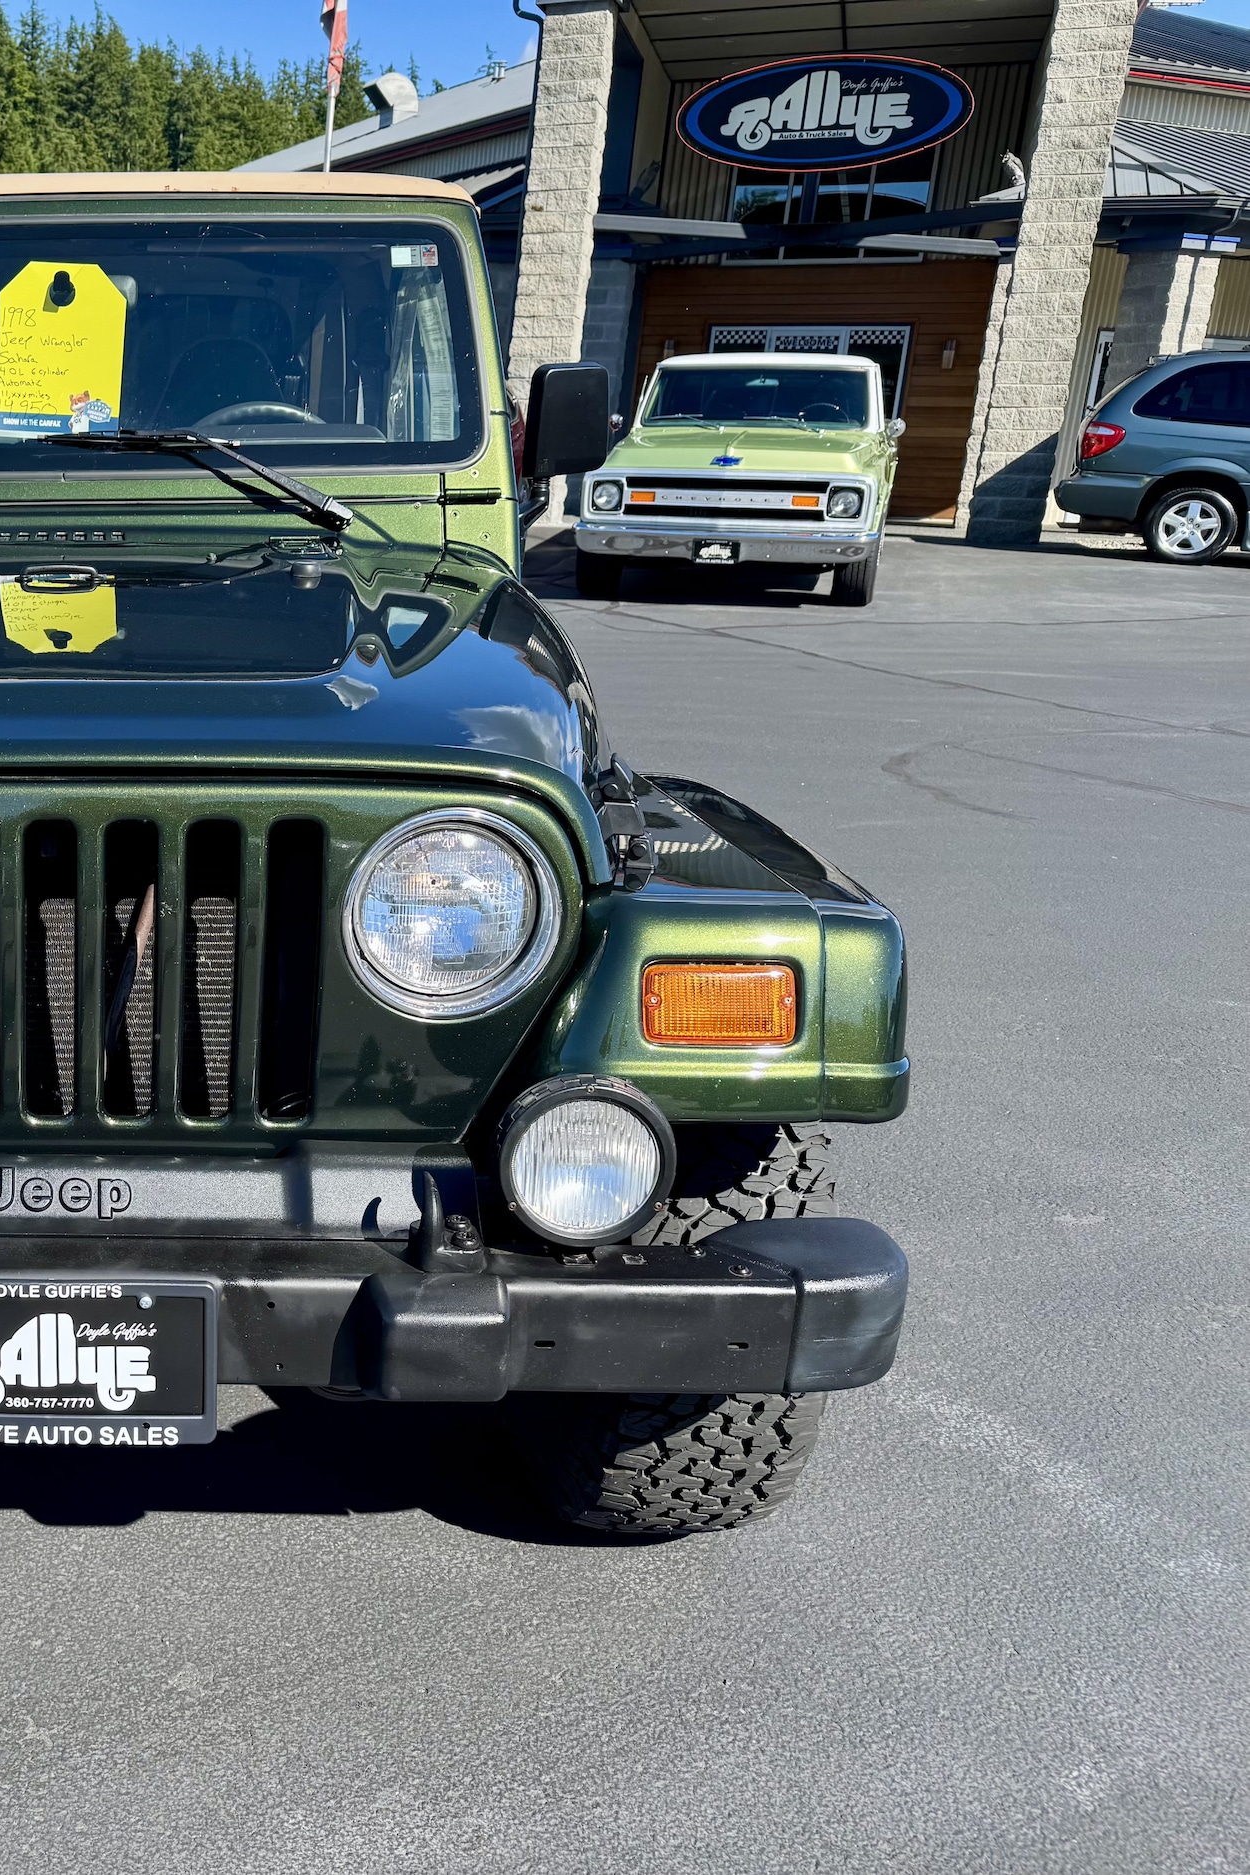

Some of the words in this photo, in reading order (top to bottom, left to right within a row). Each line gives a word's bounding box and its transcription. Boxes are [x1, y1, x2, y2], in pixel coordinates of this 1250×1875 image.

[841, 79, 868, 91] Doyle
[870, 75, 905, 92] Guffie's
[778, 132, 796, 140] Auto
[805, 131, 826, 139] Truck
[826, 129, 848, 138] Sales
[2, 306, 37, 328] 1998
[0, 331, 33, 350] Jeep
[40, 334, 89, 353] Wrangler
[783, 338, 833, 347] WELCOME
[0, 351, 38, 365] Sahara
[38, 366, 69, 377] cylinder
[3, 417, 20, 425] SHOW
[20, 418, 29, 426] ME
[29, 419, 39, 427] THE
[39, 419, 61, 428] CARFAX
[44, 1284, 123, 1299] GUFFIE'S
[76, 1323, 111, 1342] Doyle
[112, 1322, 157, 1342] Guffie's
[5, 1397, 95, 1409] 360-757-7770
[25, 1425, 93, 1446] AUTO
[99, 1426, 180, 1446] SALES
